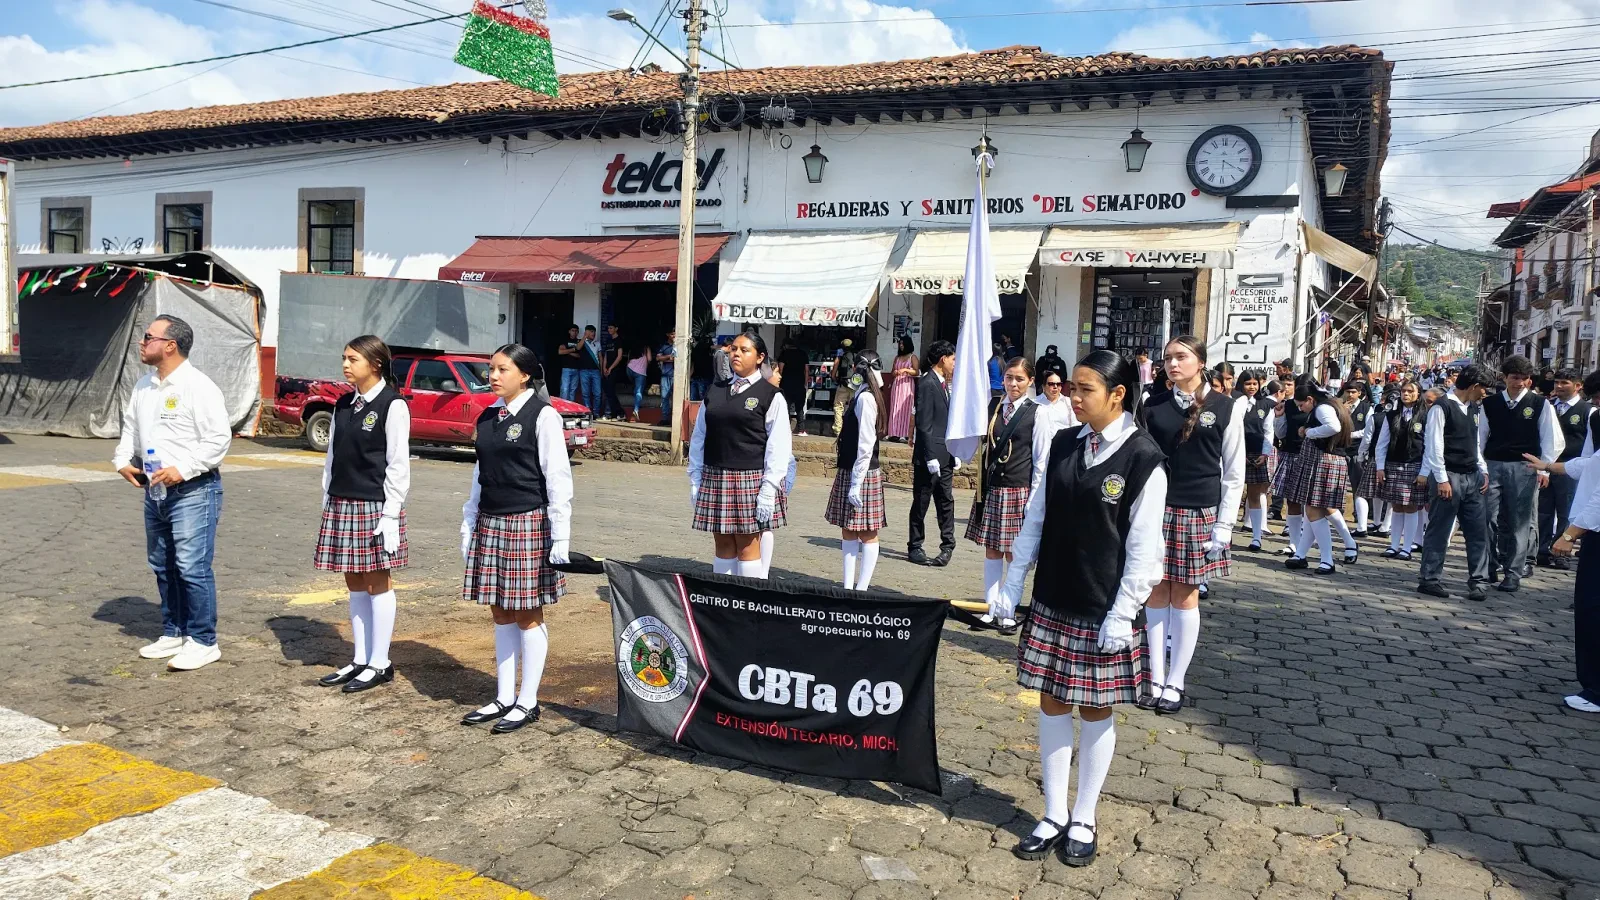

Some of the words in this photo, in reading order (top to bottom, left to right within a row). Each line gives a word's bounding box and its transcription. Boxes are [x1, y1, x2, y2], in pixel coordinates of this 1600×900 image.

[600, 200, 662, 210] DISTRIBUIDOR
[662, 198, 722, 208] AUTZADO
[796, 200, 890, 218] REGADERAS
[900, 200, 913, 216] Y
[922, 198, 1024, 215] SANITRIOS
[1041, 196, 1074, 213] DEL
[1082, 192, 1186, 214] SEMAFORO
[1060, 252, 1105, 262] CASE
[1125, 252, 1206, 264] YAHWEH
[460, 270, 486, 282] telcel
[548, 272, 576, 282] telcel
[644, 270, 671, 281] telcel
[894, 277, 942, 290] BAÑOS
[715, 303, 789, 320] TELCEL
[800, 308, 816, 321] El
[824, 308, 865, 323] David
[690, 594, 730, 608] CENTRO
[732, 600, 746, 610] DE
[748, 602, 826, 620] BACHILLERATO
[830, 612, 911, 627] TECNOLÓGICO
[801, 622, 872, 638] agropecuario
[876, 629, 894, 639] No.
[898, 630, 910, 640] 69
[738, 664, 838, 714] CBTa
[848, 678, 904, 717] 69
[716, 712, 788, 740] EXTENSIÓN
[790, 727, 858, 750] TECARIO,
[862, 735, 899, 750] MICH.
